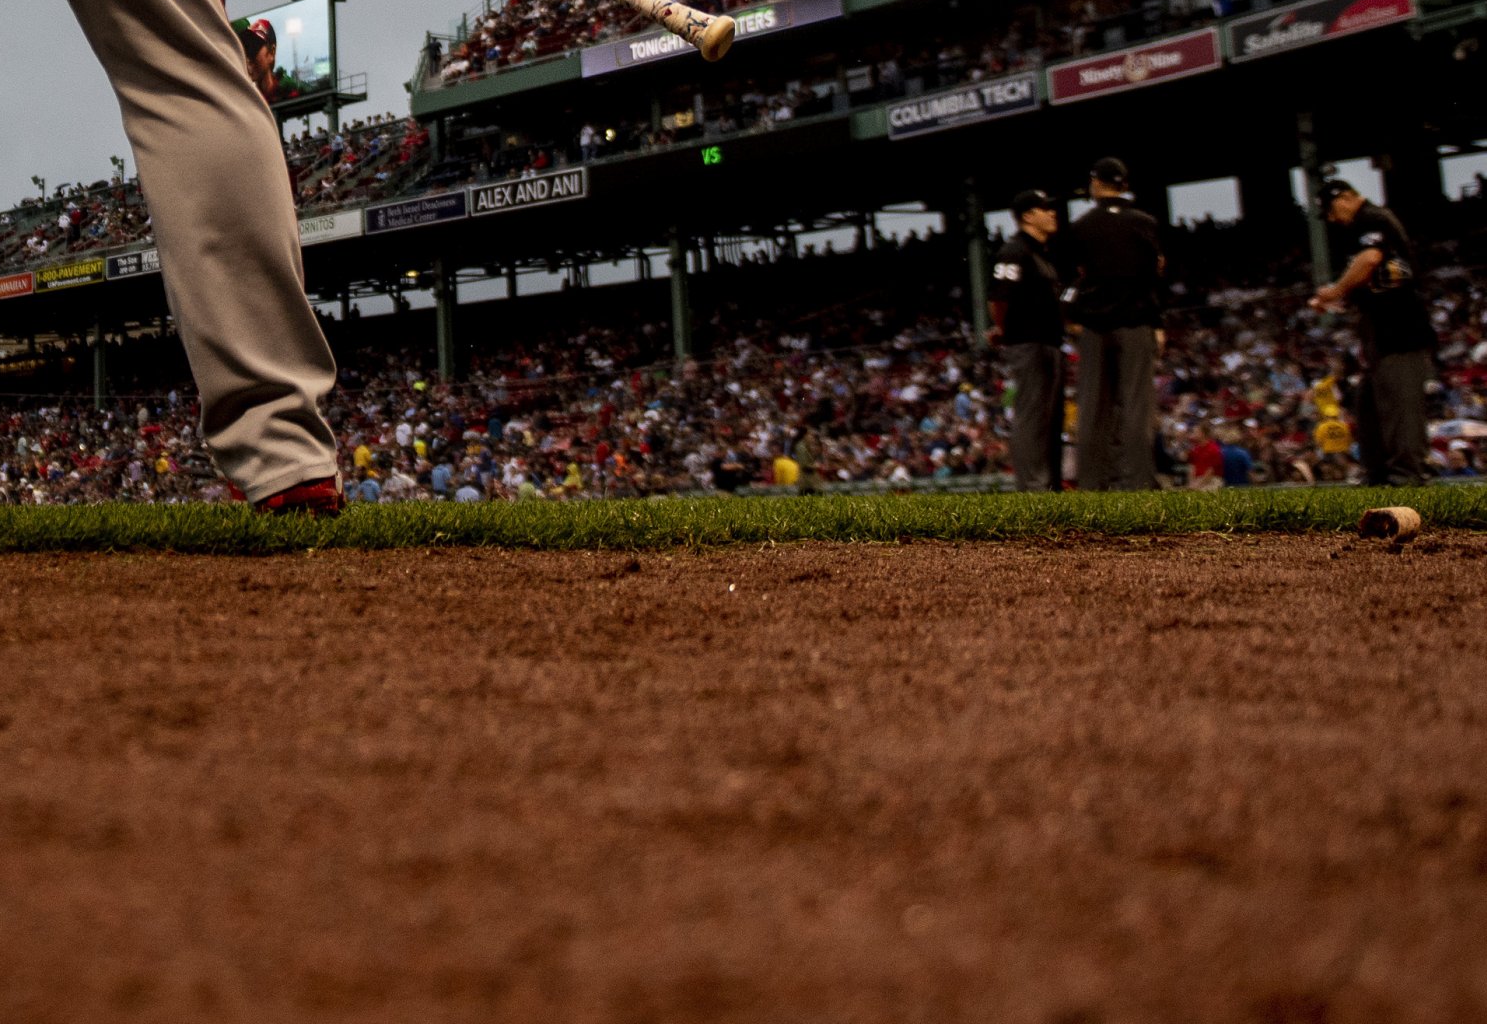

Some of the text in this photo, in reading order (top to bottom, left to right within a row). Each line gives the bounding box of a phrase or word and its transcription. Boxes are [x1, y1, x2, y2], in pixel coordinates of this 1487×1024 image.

[629, 10, 776, 60] TONIGHT TERS
[889, 90, 980, 127] COLUMBIA
[981, 79, 1032, 106] TECH
[476, 174, 580, 210] ALEX AND ANI
[299, 216, 334, 235] ORNITOS
[388, 212, 437, 227] Medical Center
[36, 261, 102, 283] 1-800-PAVEMENT
